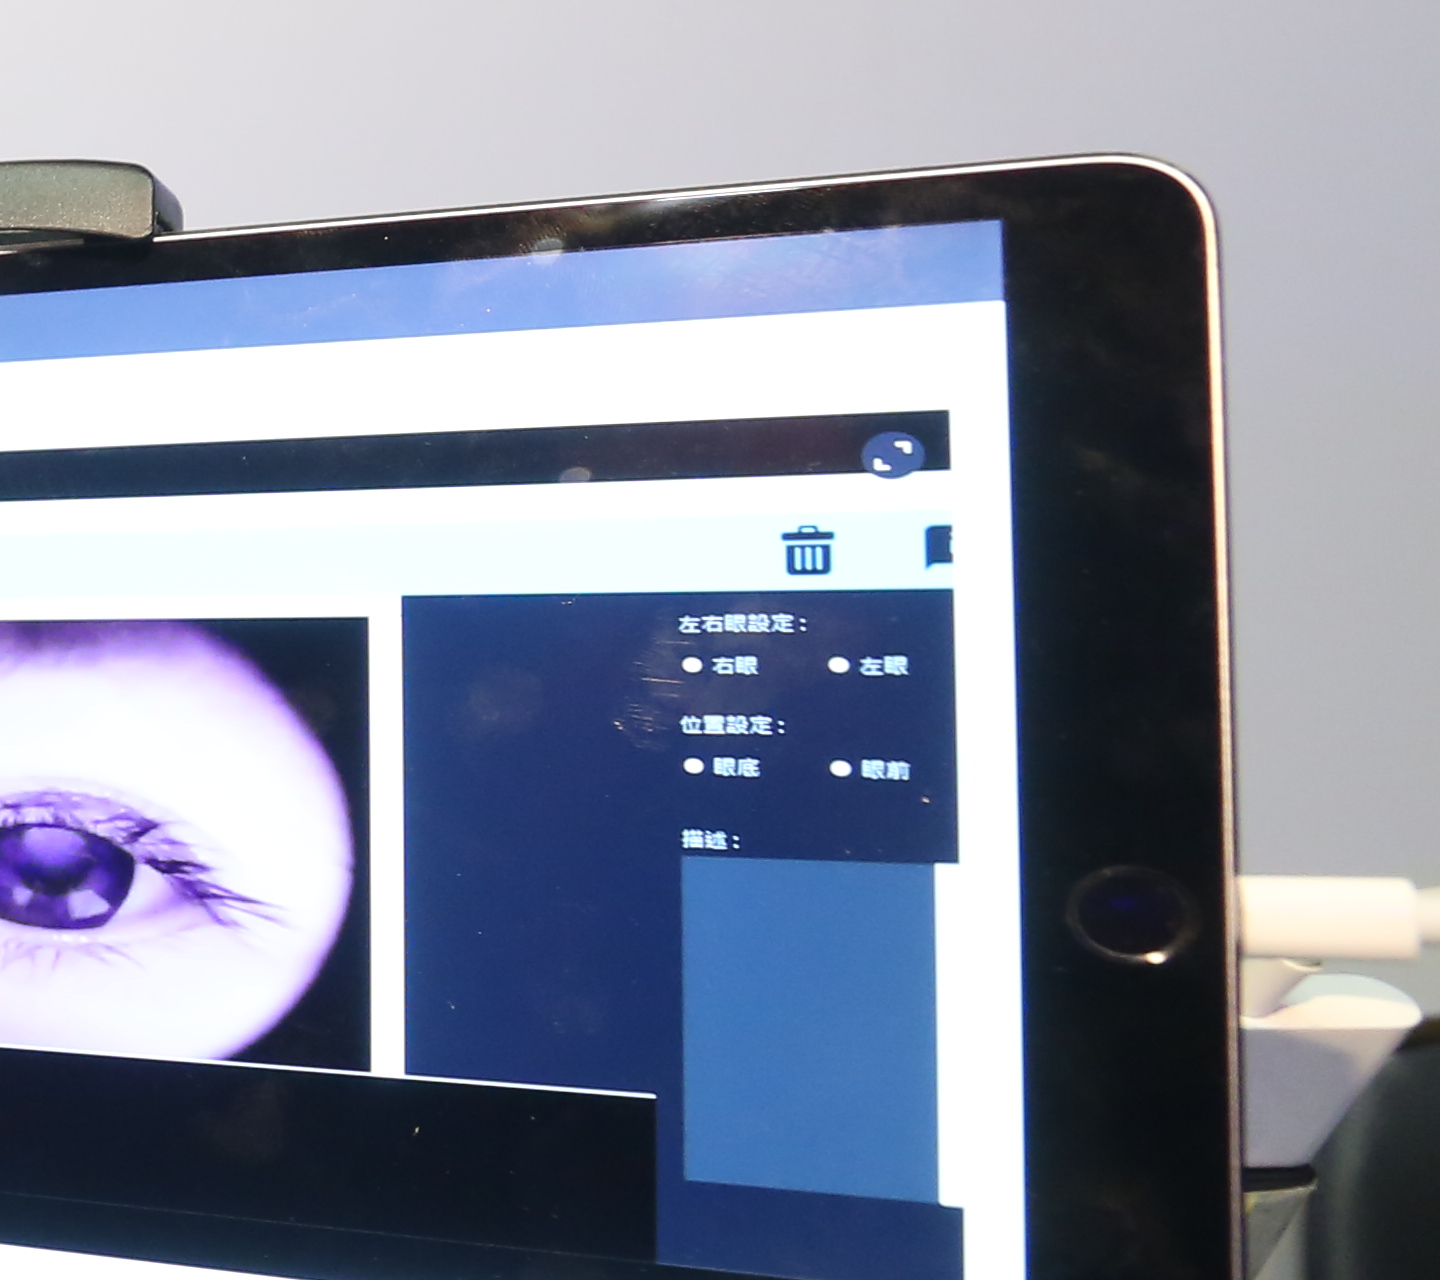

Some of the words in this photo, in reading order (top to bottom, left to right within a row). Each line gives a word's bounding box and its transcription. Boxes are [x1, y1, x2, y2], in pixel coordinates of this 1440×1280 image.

[711, 655, 759, 676] 右眼
[859, 655, 910, 677] 左眼
[712, 756, 762, 778] 眼底
[861, 758, 912, 781] 眼前
